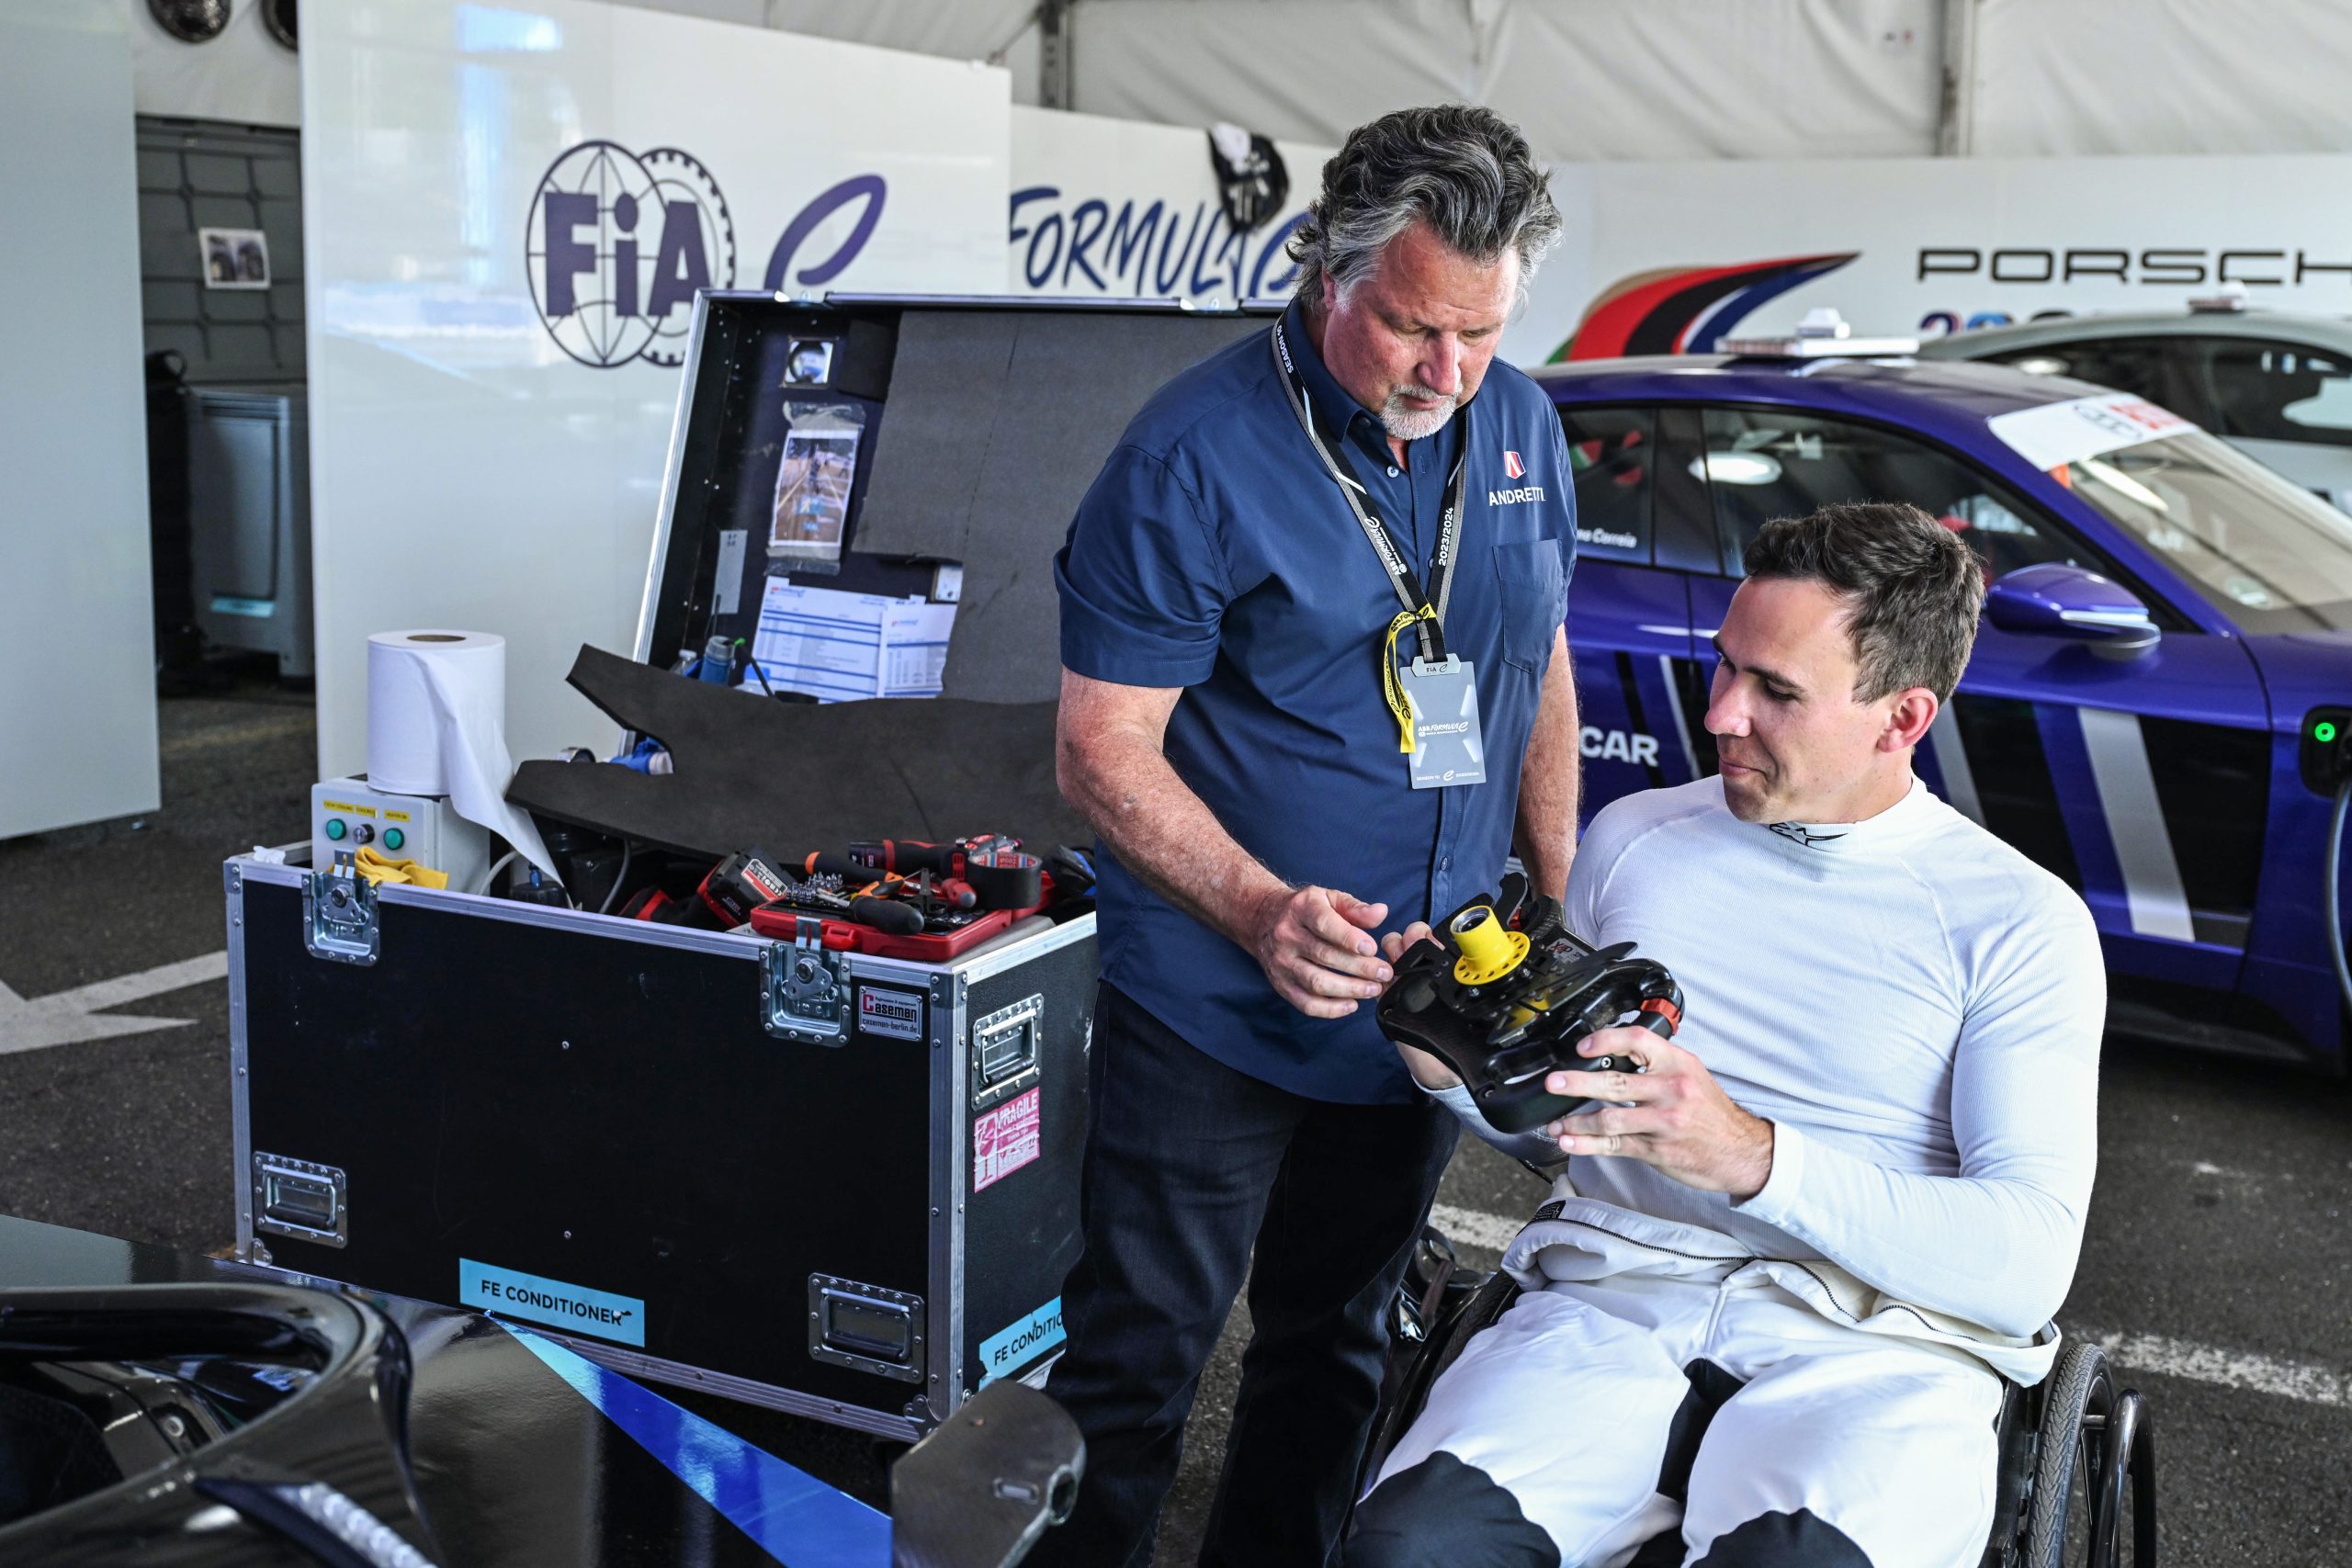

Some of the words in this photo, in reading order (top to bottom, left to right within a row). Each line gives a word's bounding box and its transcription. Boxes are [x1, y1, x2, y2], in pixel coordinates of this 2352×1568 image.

[1278, 335, 1295, 374] SEASON
[1488, 486, 1545, 506] ANDRETTI
[1438, 507, 1454, 567] 2023/2024
[1580, 726, 1659, 766] CAR
[862, 994, 917, 1023] Caseman
[862, 1018, 918, 1033] caseman-berlin.de
[996, 1092, 1038, 1129] FRAGILE
[481, 1279, 501, 1297] FE
[505, 1285, 622, 1326] CONDITIONER
[993, 1345, 1009, 1367] FE
